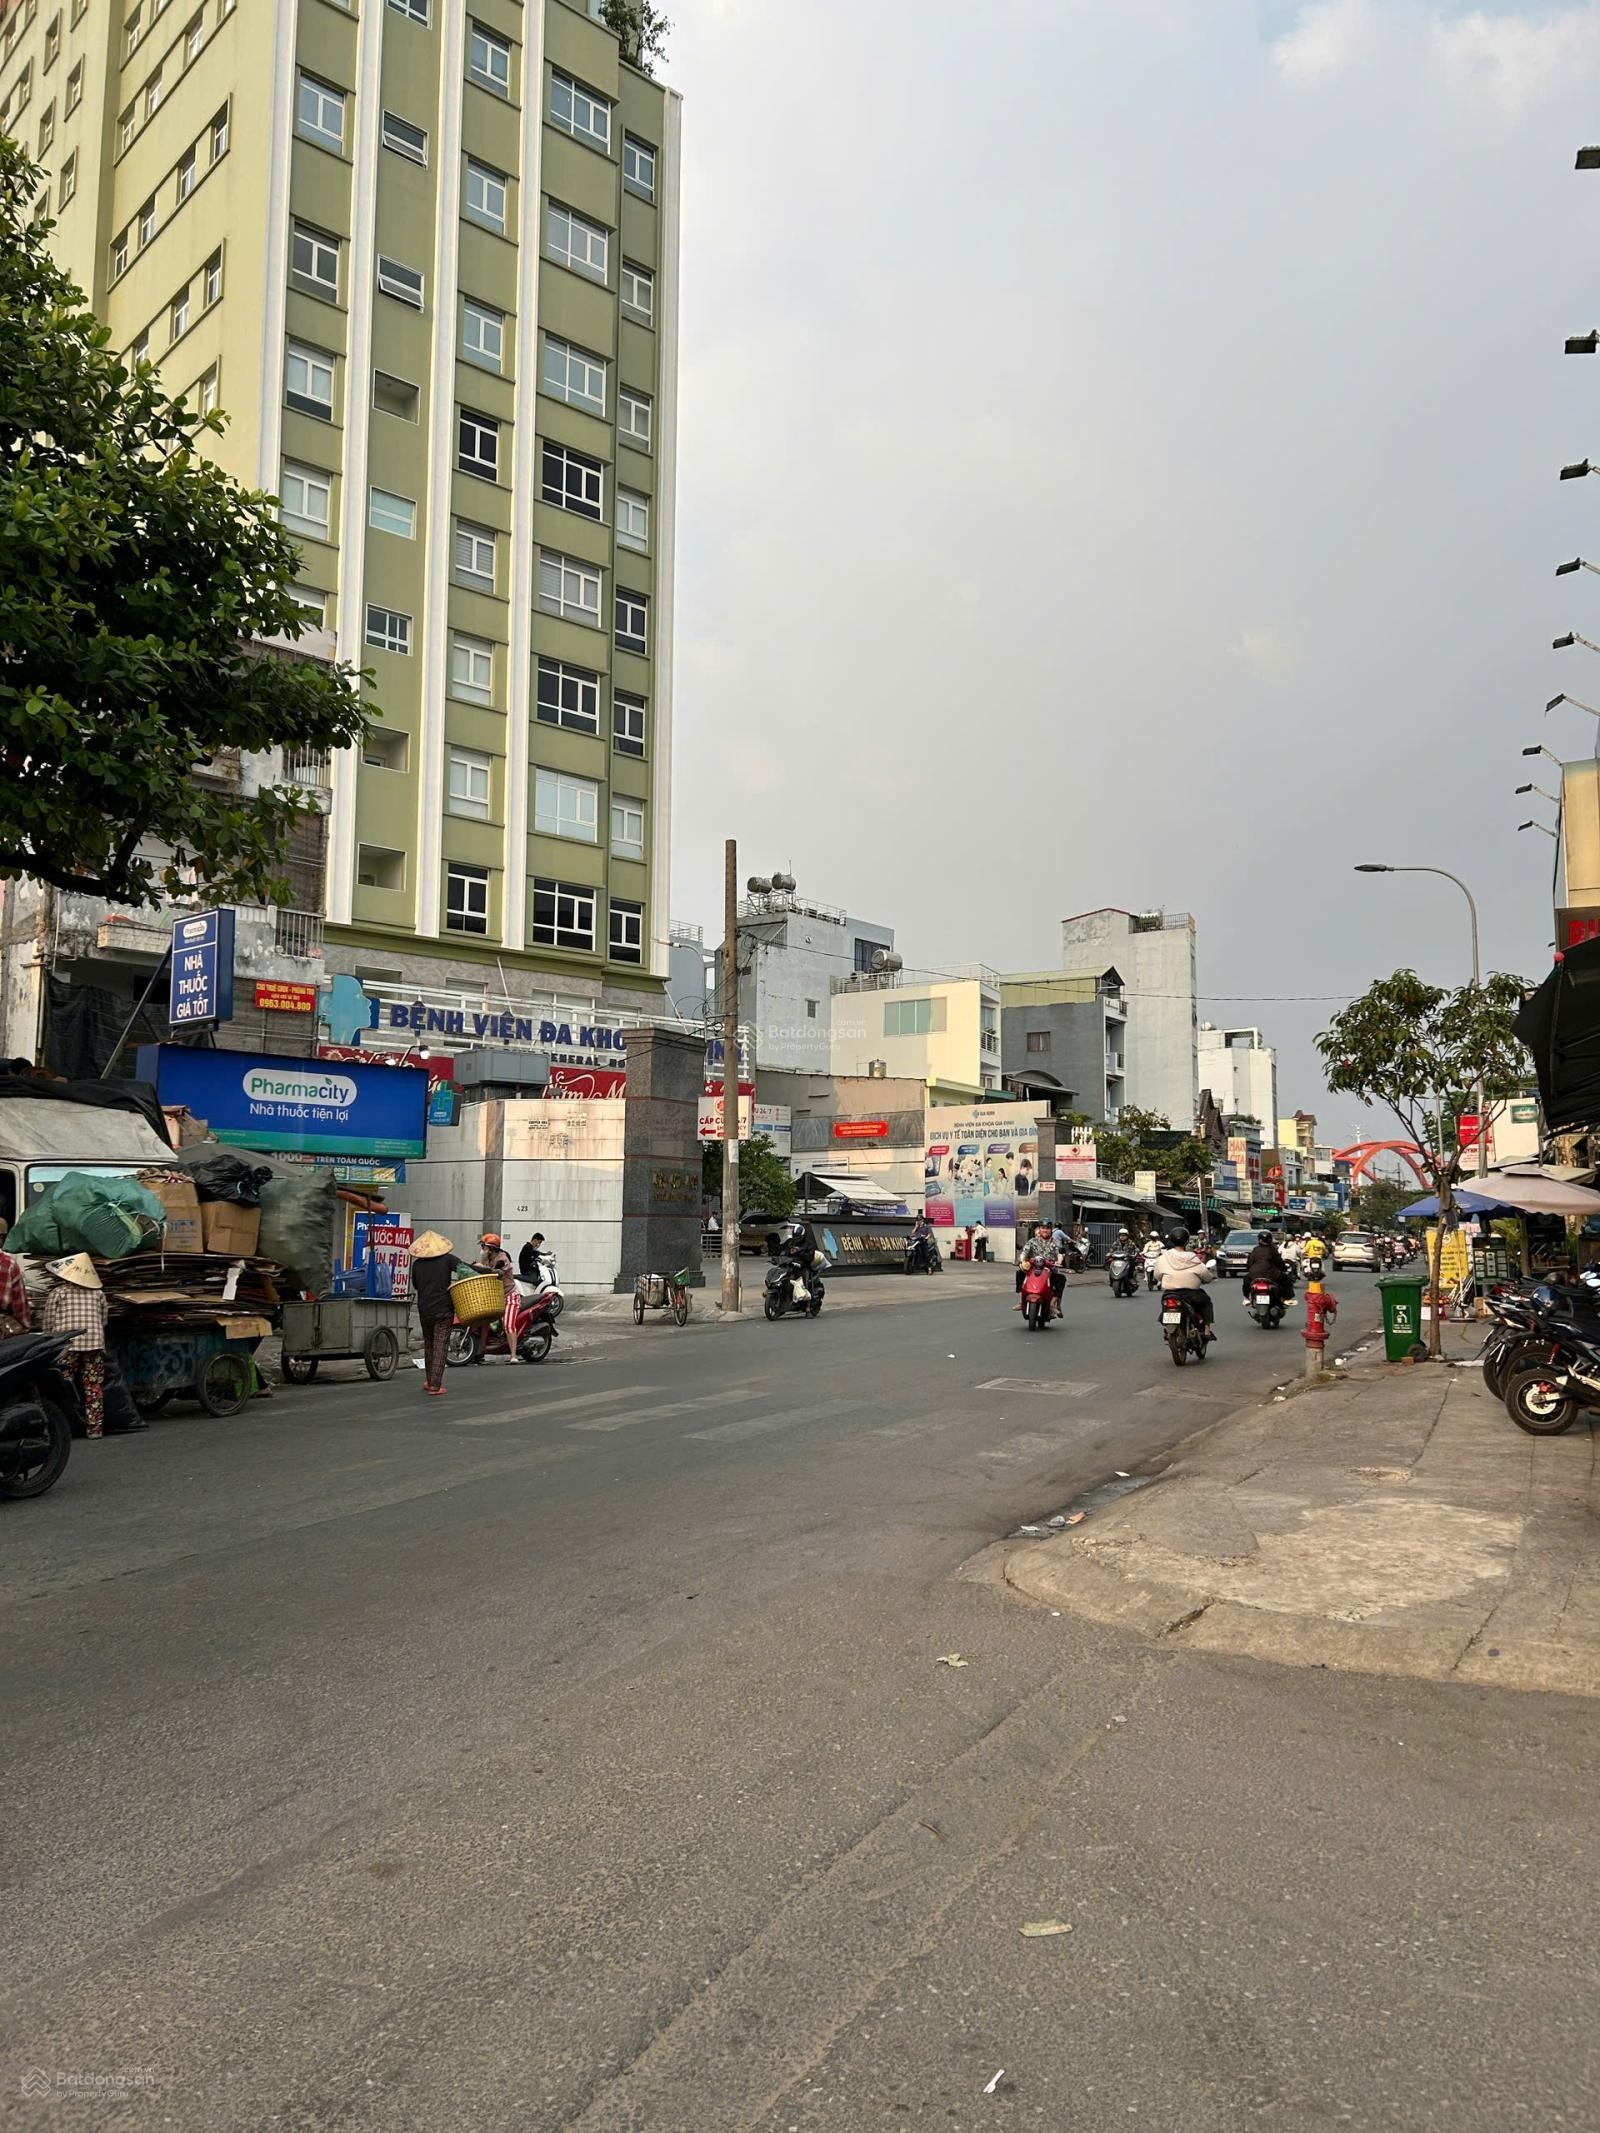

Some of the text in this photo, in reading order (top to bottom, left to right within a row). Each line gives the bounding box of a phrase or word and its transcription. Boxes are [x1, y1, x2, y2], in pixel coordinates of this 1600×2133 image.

[184, 950, 203, 971] NHÀ
[178, 970, 208, 995] THUỐC
[176, 993, 208, 1018] GIÁ TỐT
[390, 1000, 464, 1036] BỆNH
[473, 1010, 532, 1045] VIỆN
[540, 1021, 572, 1045] ĐA
[580, 1026, 627, 1050] KHO
[550, 1053, 600, 1066] ENERAL
[251, 1077, 349, 1103] Pharmacity
[249, 1102, 349, 1121] Nhà thuốc tiện lợi
[699, 1116, 714, 1124] CẤP
[949, 1131, 954, 1139] Y
[954, 1128, 961, 1139] TẾ
[961, 1128, 974, 1139] TOÀN
[987, 1129, 998, 1138] CHO
[316, 1155, 335, 1164] TRÊN
[337, 1155, 358, 1165] TOÀN
[359, 1156, 380, 1166] QUỐC
[367, 1229, 411, 1246] ƯỚC MÍA
